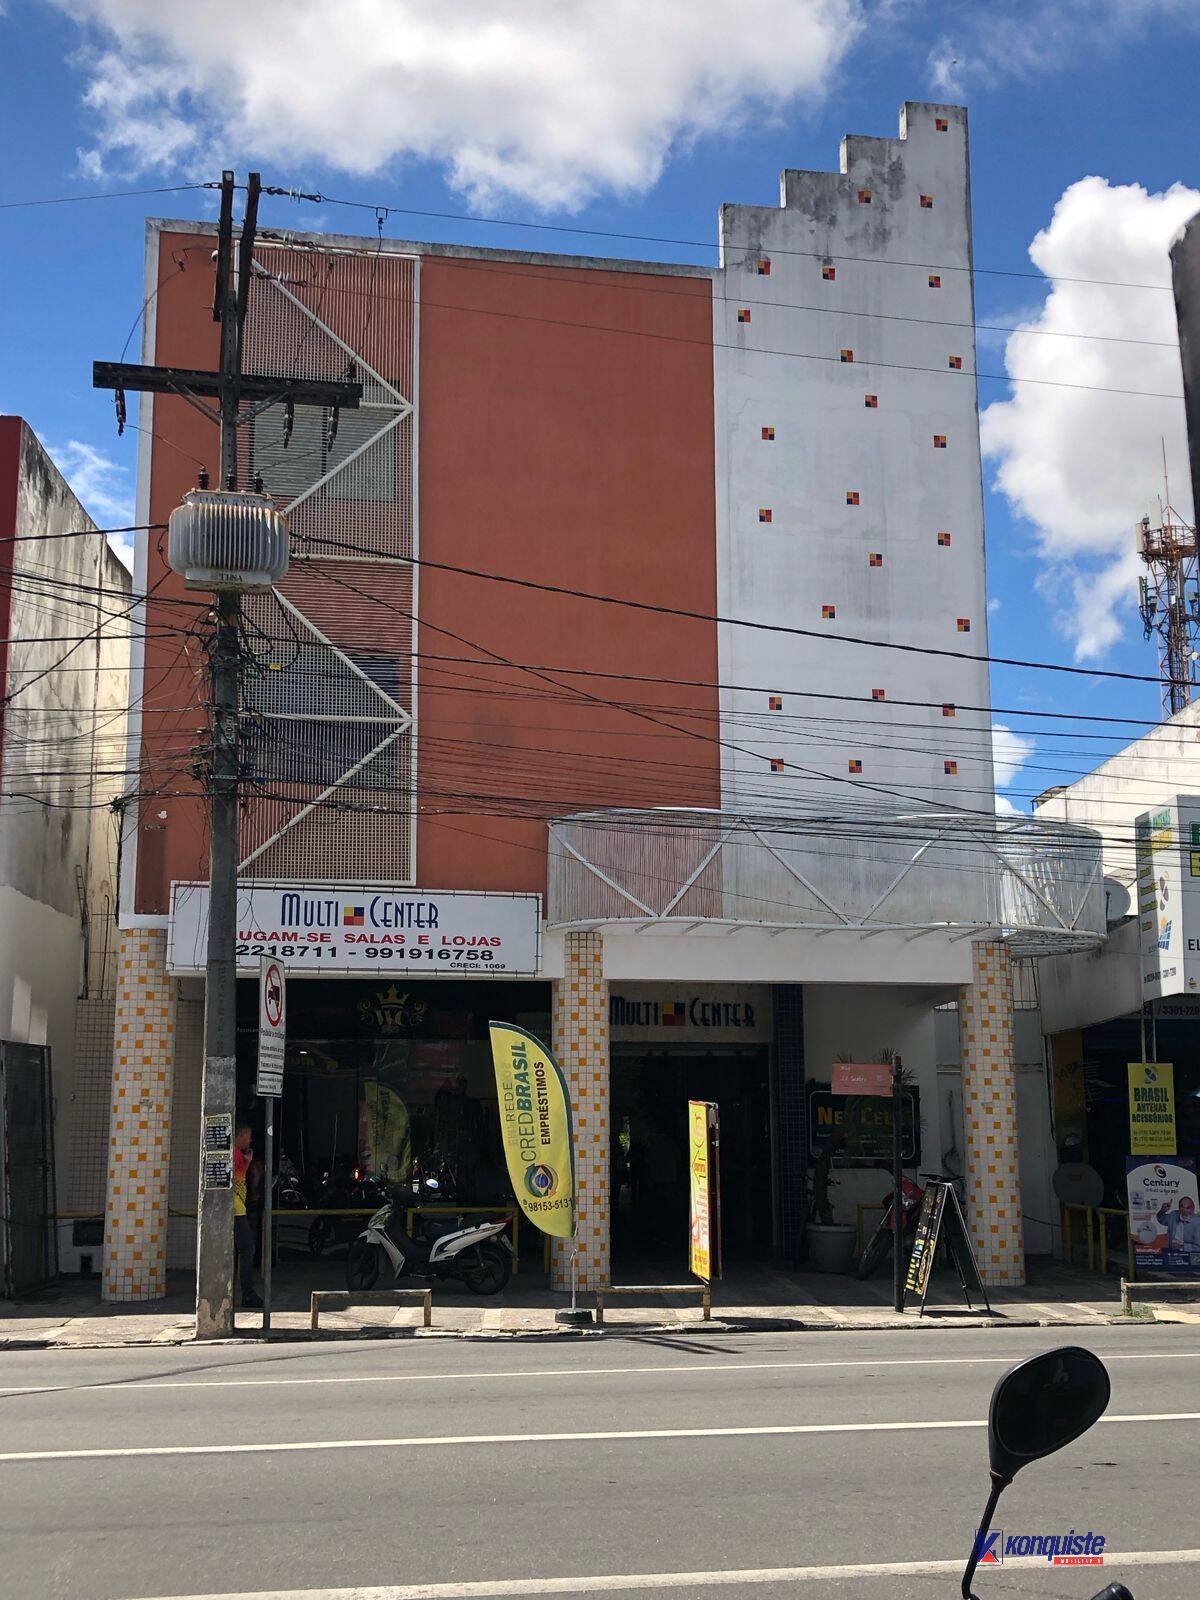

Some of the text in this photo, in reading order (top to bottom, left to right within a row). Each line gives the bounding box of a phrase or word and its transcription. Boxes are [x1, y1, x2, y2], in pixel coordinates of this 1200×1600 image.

[281, 893, 439, 929] MULTI CENTER
[235, 930, 502, 947] UGAM-SE SALAS E LOJAS
[364, 947, 494, 961] 991916758
[610, 995, 756, 1027] MULTI CENTER
[502, 1081, 515, 1122] REDE
[533, 1061, 551, 1146] EMPRÉSTIMOS
[1133, 1087, 1170, 1103] BRASIL
[1136, 1102, 1168, 1113] ANTENAS
[1142, 1177, 1181, 1189] Century
